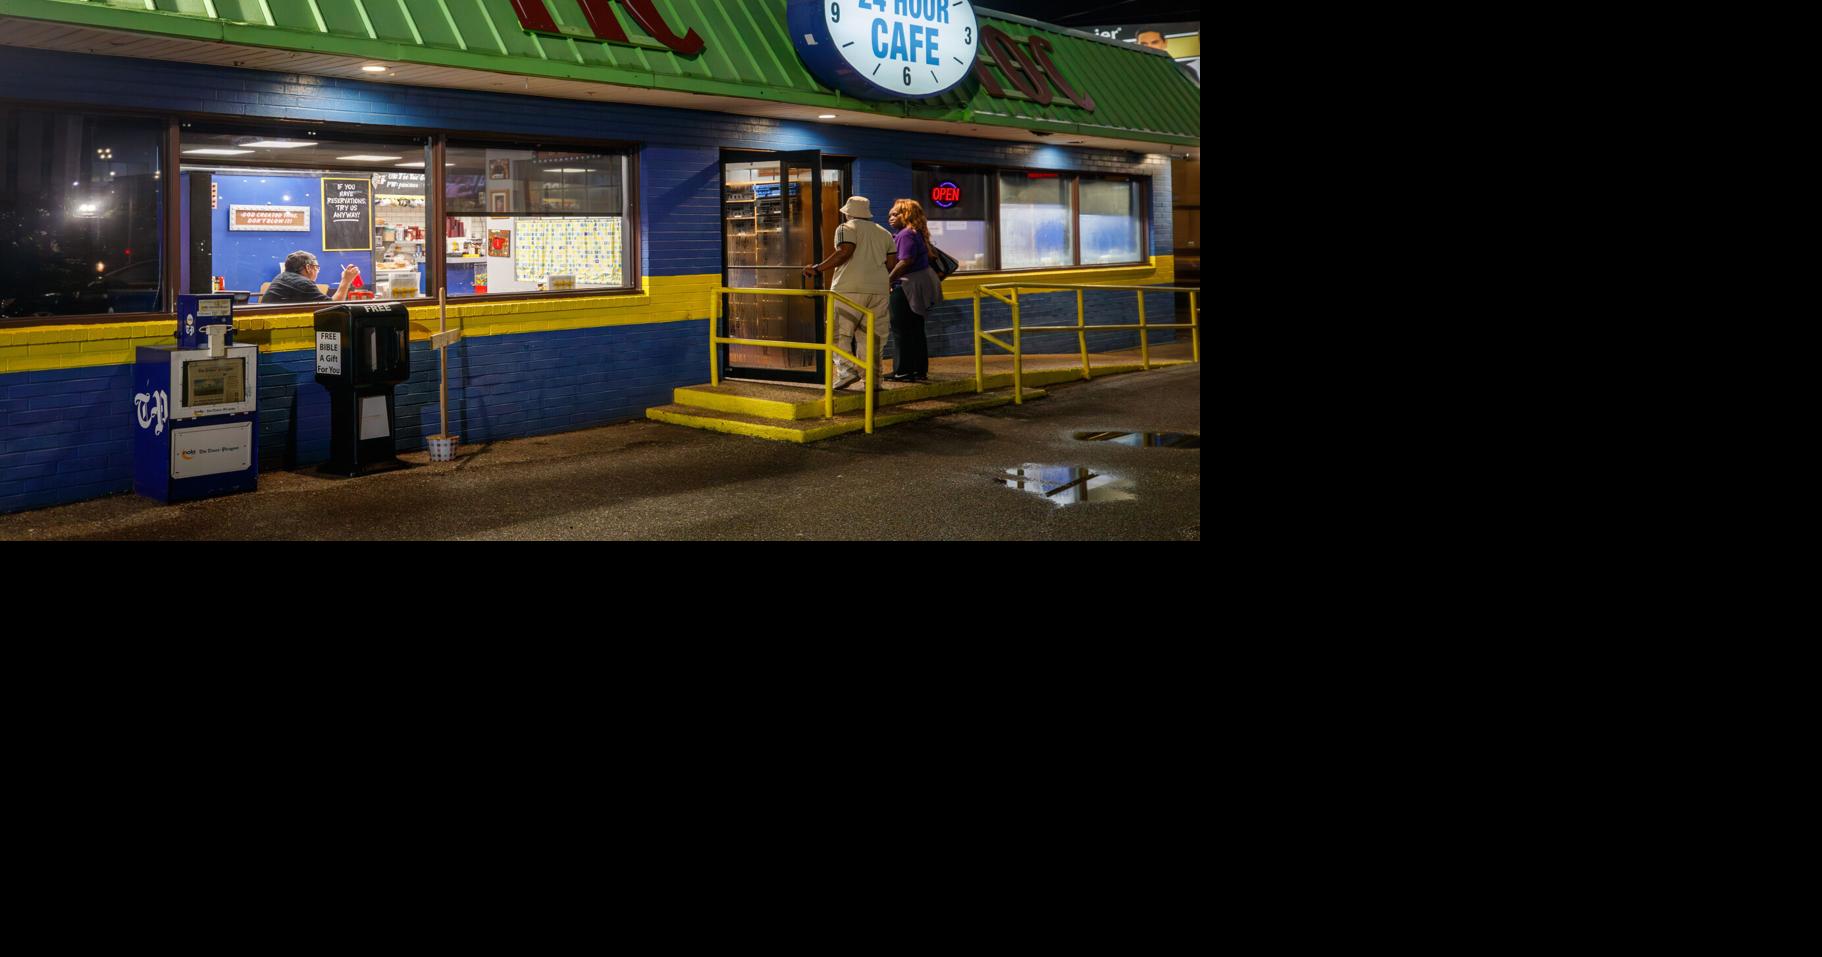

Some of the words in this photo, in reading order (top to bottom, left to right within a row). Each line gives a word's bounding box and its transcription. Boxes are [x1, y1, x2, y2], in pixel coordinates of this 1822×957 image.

[831, 2, 840, 23] 9
[894, 0, 949, 24] HOUR
[871, 17, 940, 66] CAFE
[964, 26, 972, 45] 3
[903, 66, 911, 86] 6
[931, 187, 960, 201] OPEN
[364, 305, 392, 313] FREE
[320, 332, 337, 340] FREE
[319, 343, 338, 351] BIBLE
[319, 354, 324, 362] A
[325, 354, 338, 362] Gift
[317, 365, 328, 373] For
[329, 366, 340, 374] You
